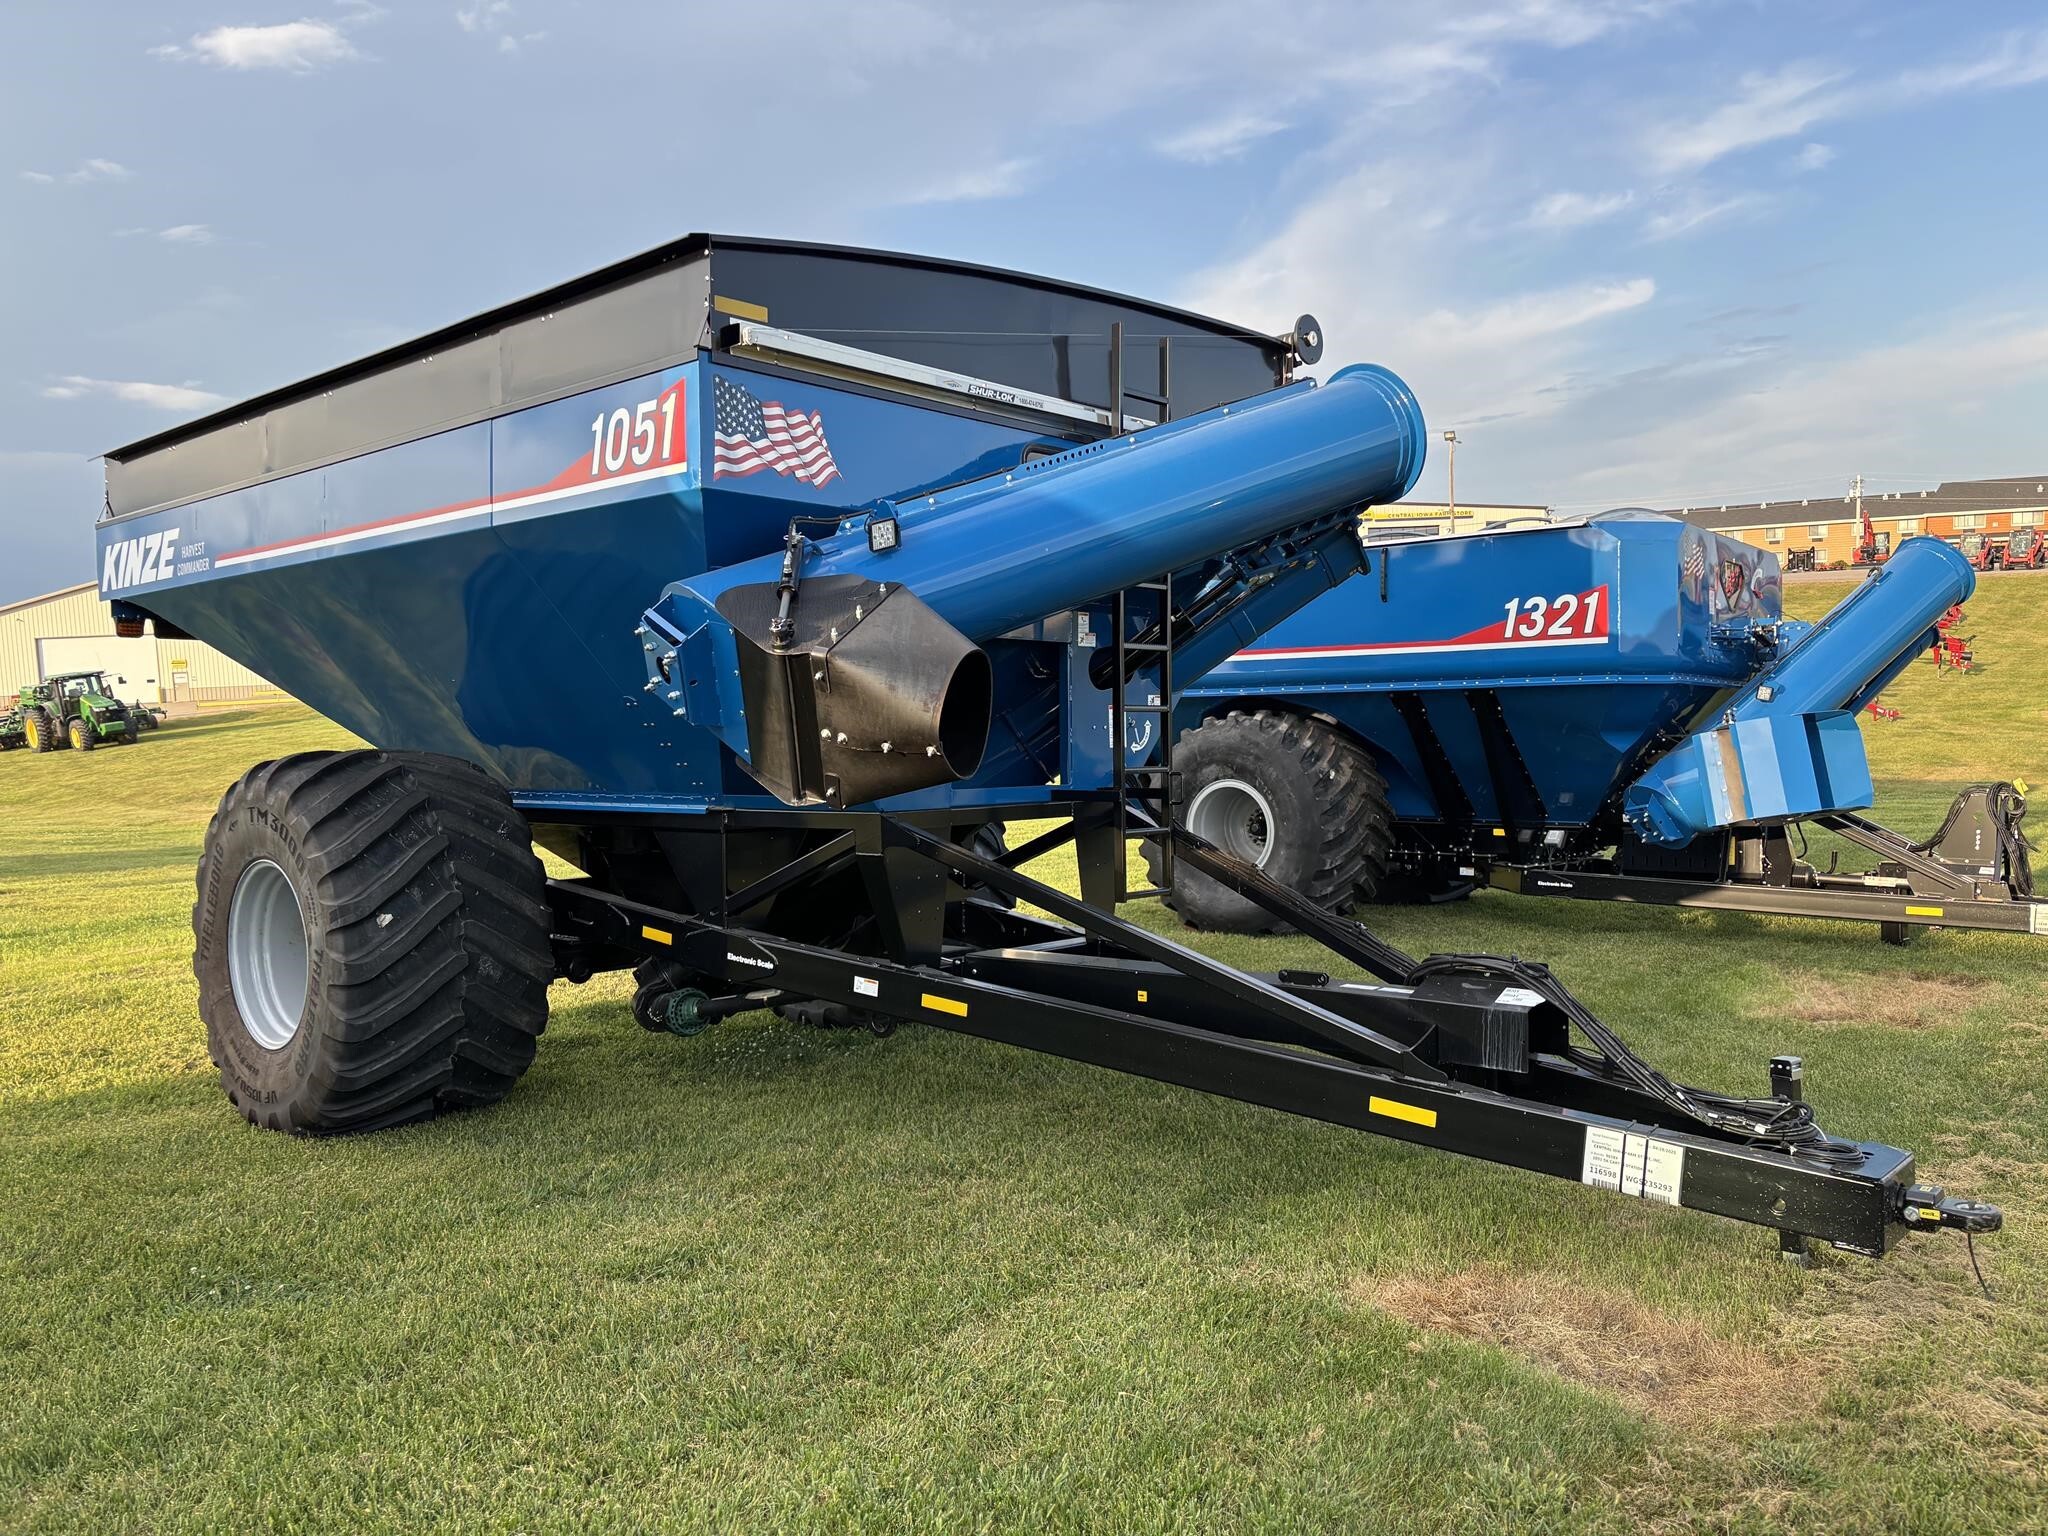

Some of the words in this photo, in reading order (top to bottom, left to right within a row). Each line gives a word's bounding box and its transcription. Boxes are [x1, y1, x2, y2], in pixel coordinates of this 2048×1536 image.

[591, 392, 677, 476] 1051
[102, 528, 180, 592] KINZE
[177, 558, 210, 576] COMMANDER
[181, 542, 205, 559] HARVEST
[1504, 591, 1600, 638] 1321
[248, 806, 306, 877] TM3000
[200, 842, 225, 961] TRELLEBORG
[727, 952, 756, 967] Electronic
[756, 959, 774, 970] Scale
[1589, 1166, 1617, 1179] 116598
